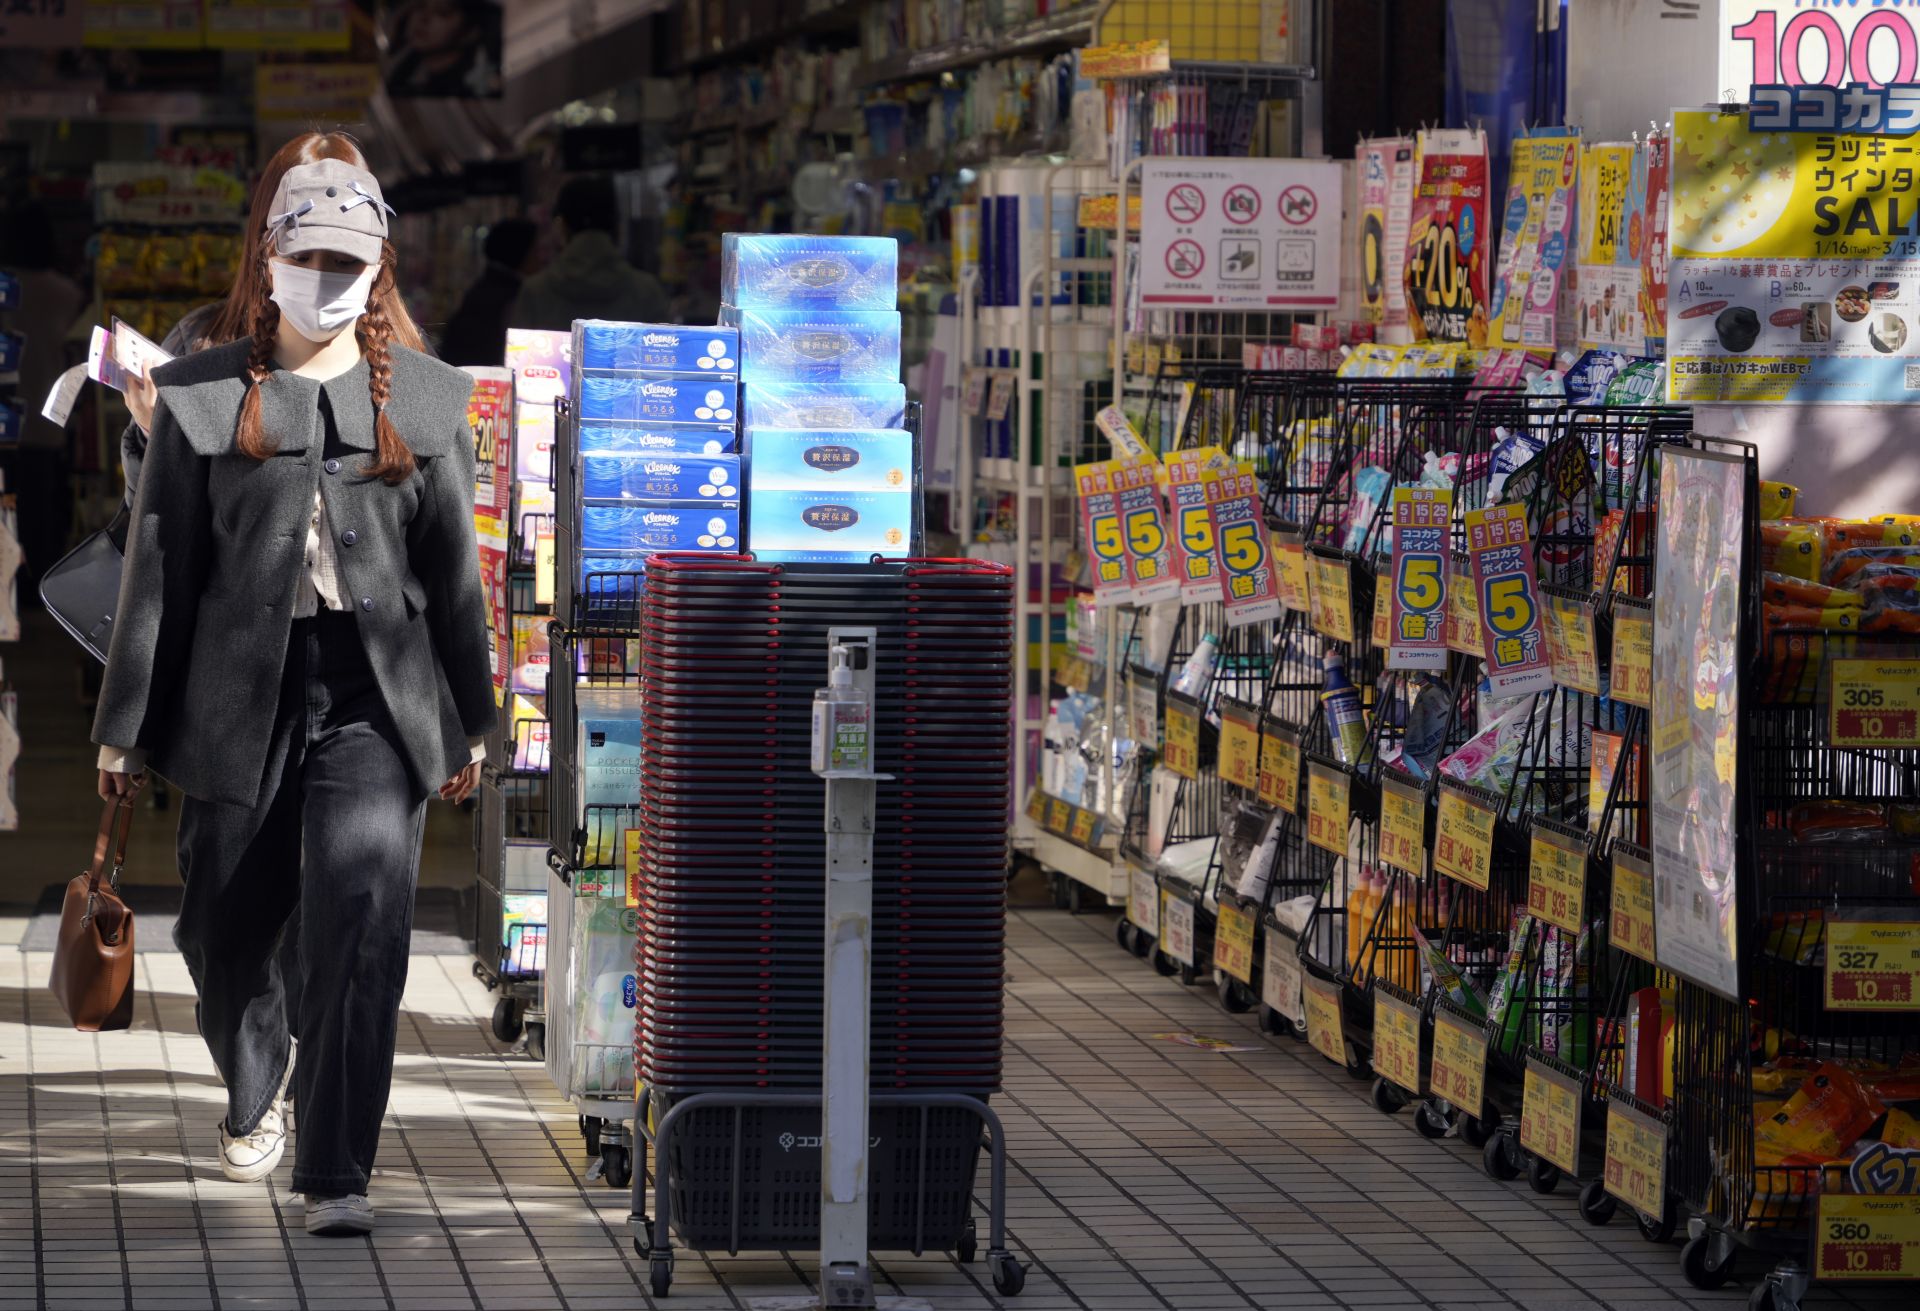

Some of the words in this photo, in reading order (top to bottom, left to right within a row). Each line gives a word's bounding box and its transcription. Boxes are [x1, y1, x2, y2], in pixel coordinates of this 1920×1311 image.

[1815, 137, 1913, 162] ラッキー
[1815, 167, 1920, 192] ウィンタ
[1600, 215, 1624, 246] SALE
[1679, 280, 1691, 297] A
[1771, 281, 1782, 297] B
[643, 333, 680, 347] Kleenex
[641, 384, 678, 397] Kleenex
[639, 433, 677, 447] Kleenex
[644, 461, 681, 475] Kleenex
[1120, 486, 1152, 500] ココカラ
[1209, 483, 1218, 495] 5
[1224, 479, 1235, 491] 15
[1239, 475, 1251, 488] 25
[1121, 495, 1154, 510] ポイント
[1411, 491, 1434, 500] 毎月
[1216, 498, 1251, 513] ココカラ
[1400, 504, 1408, 516] 5
[1416, 504, 1429, 516] 15
[1433, 504, 1447, 517] 25
[1484, 508, 1507, 521] 毎月
[643, 512, 680, 525] Kleenex
[1217, 509, 1253, 524] ポイント
[1092, 514, 1123, 559] 5
[1125, 507, 1163, 556] 5
[1180, 506, 1213, 554] 5
[1402, 529, 1442, 540] ココカラ
[1474, 527, 1483, 540] 5
[1490, 523, 1504, 537] 15
[1509, 519, 1523, 534] 25
[1220, 521, 1264, 574] 5
[1402, 540, 1442, 551] ポイント
[1480, 546, 1522, 562] ココカラ
[1100, 562, 1122, 582] 倍
[1135, 557, 1158, 580] 倍
[1187, 556, 1210, 579] 倍
[1481, 557, 1525, 575] ポイント
[1230, 574, 1256, 599] 倍
[1399, 553, 1443, 613] 5
[1483, 572, 1536, 636] 5
[1400, 614, 1427, 641] 倍
[1427, 611, 1443, 641] デー
[1493, 636, 1524, 668] 倍
[1522, 629, 1540, 662] デー
[1844, 689, 1884, 706] 305
[1861, 717, 1883, 737] 10
[1839, 951, 1879, 969] 327
[1856, 980, 1878, 999] 10
[1830, 1223, 1870, 1240] 360
[1846, 1251, 1868, 1269] 10
